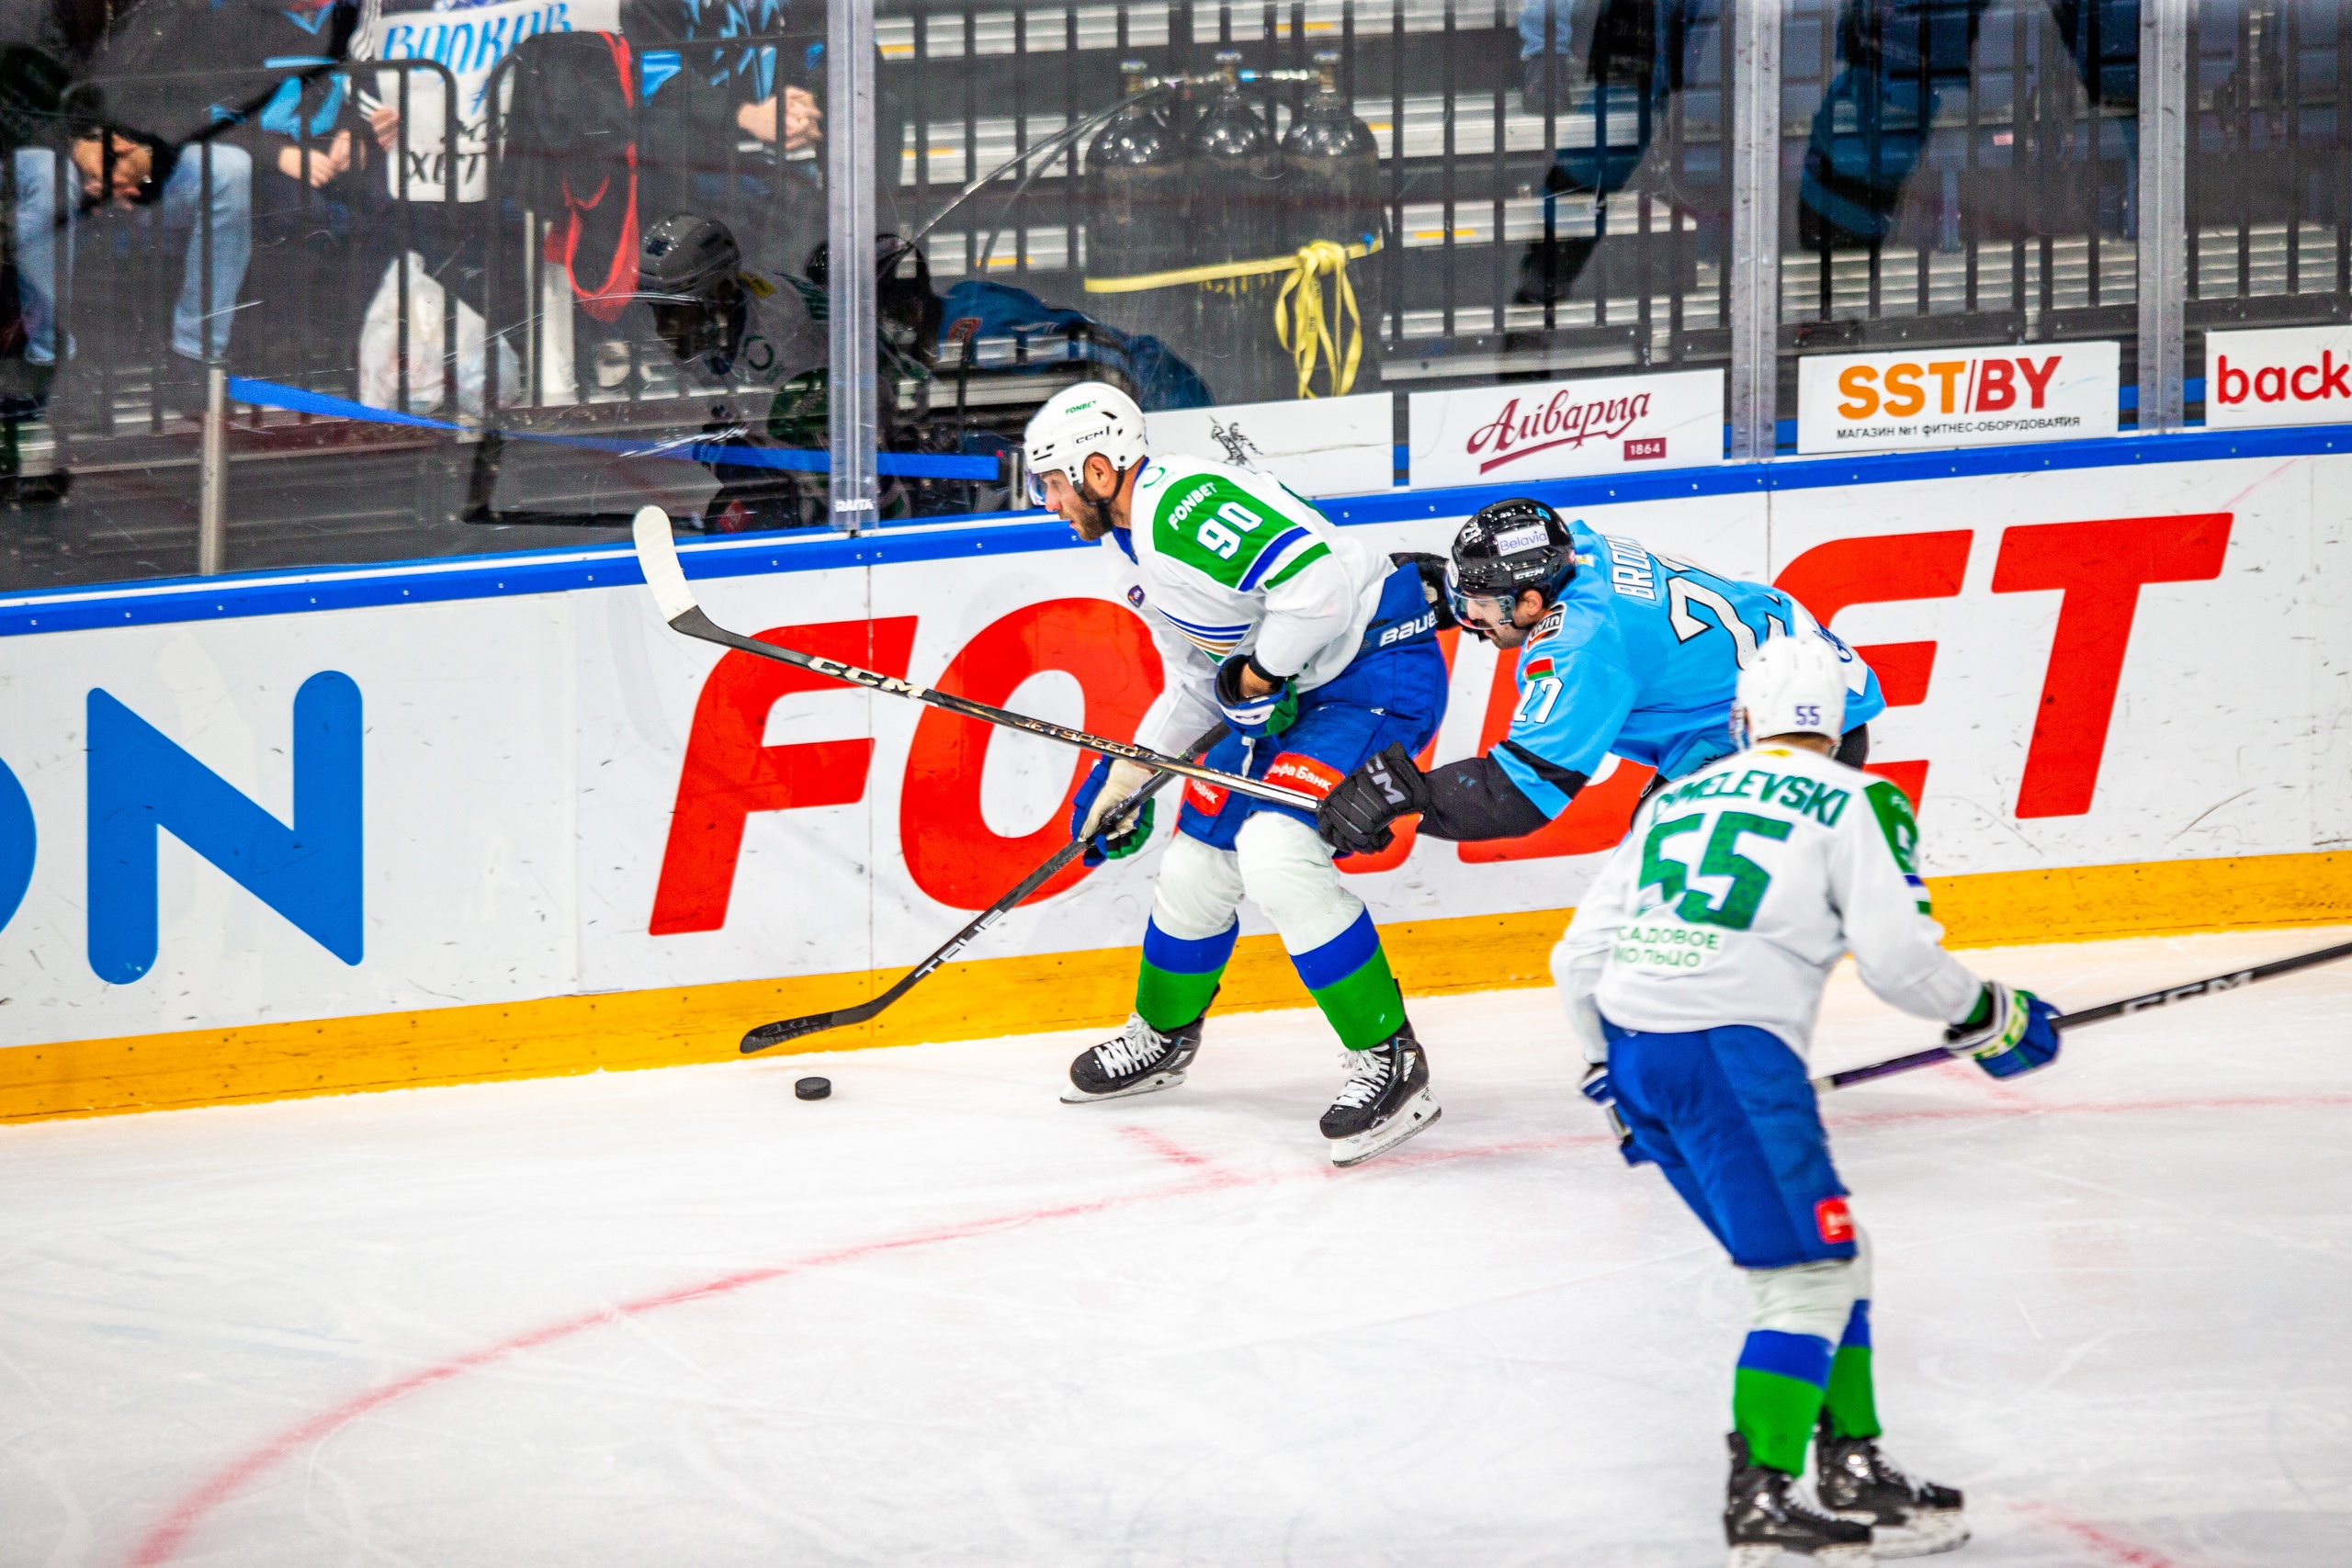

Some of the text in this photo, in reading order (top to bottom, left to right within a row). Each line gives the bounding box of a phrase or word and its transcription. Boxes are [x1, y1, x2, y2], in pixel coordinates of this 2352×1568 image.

[1066, 400, 1097, 414] FONBET
[1076, 430, 1104, 445] CCM
[1837, 427, 1895, 440] МАГАЗИН
[1630, 444, 1661, 457] 1864
[1168, 482, 1217, 531] FONBET
[1196, 502, 1264, 561] 90
[1499, 530, 1547, 551] Belavia
[1512, 568, 1545, 581] CCM
[808, 656, 928, 698] CCM
[1795, 705, 1821, 726] 55
[1296, 765, 1333, 792] Банк
[1366, 754, 1407, 805] CM
[0, 671, 364, 986] N
[1636, 810, 1793, 931] 55
[1618, 926, 1720, 951] САДОВОЕ
